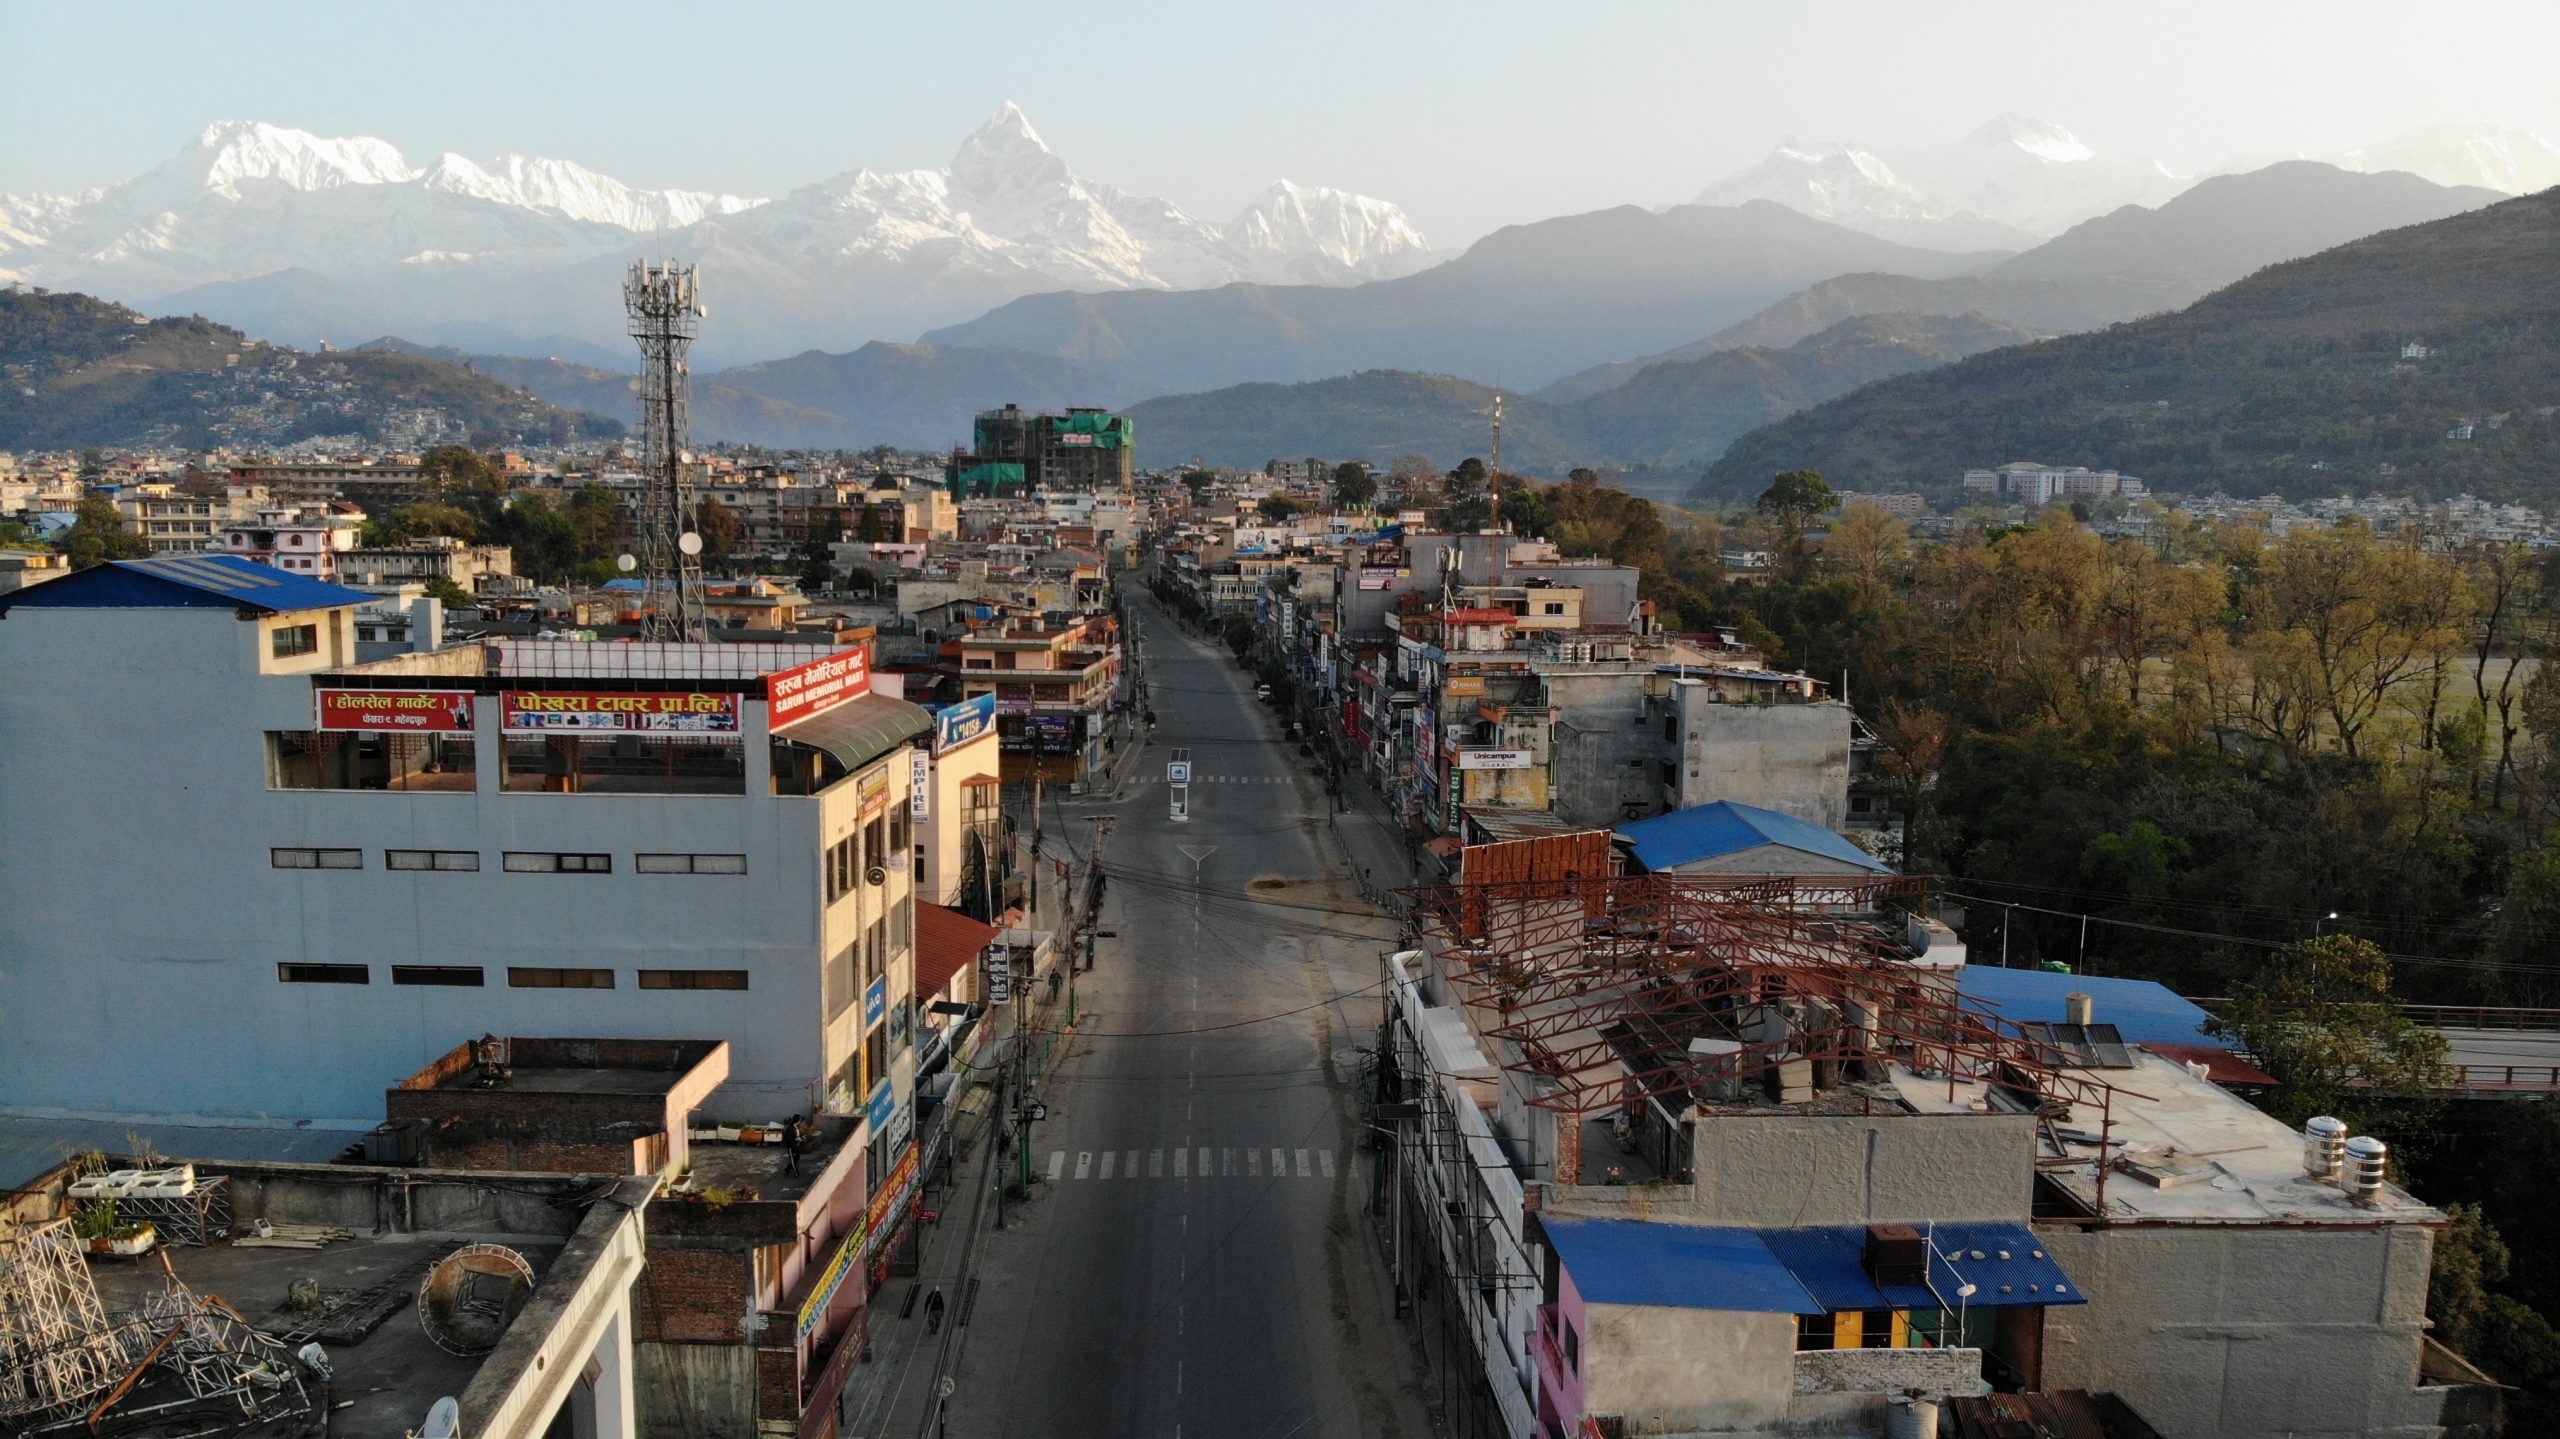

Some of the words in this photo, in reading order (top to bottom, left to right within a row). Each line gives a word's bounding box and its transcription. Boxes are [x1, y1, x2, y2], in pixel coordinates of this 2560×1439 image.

[336, 693, 392, 709] होलसेल
[518, 692, 590, 712] पोखरा
[596, 697, 652, 713] टावर
[775, 692, 804, 714] SARUN
[804, 678, 844, 703] MEMORIAL
[844, 670, 864, 688] MART
[913, 760, 926, 812] EMPIRE
[866, 992, 881, 1014] vivo
